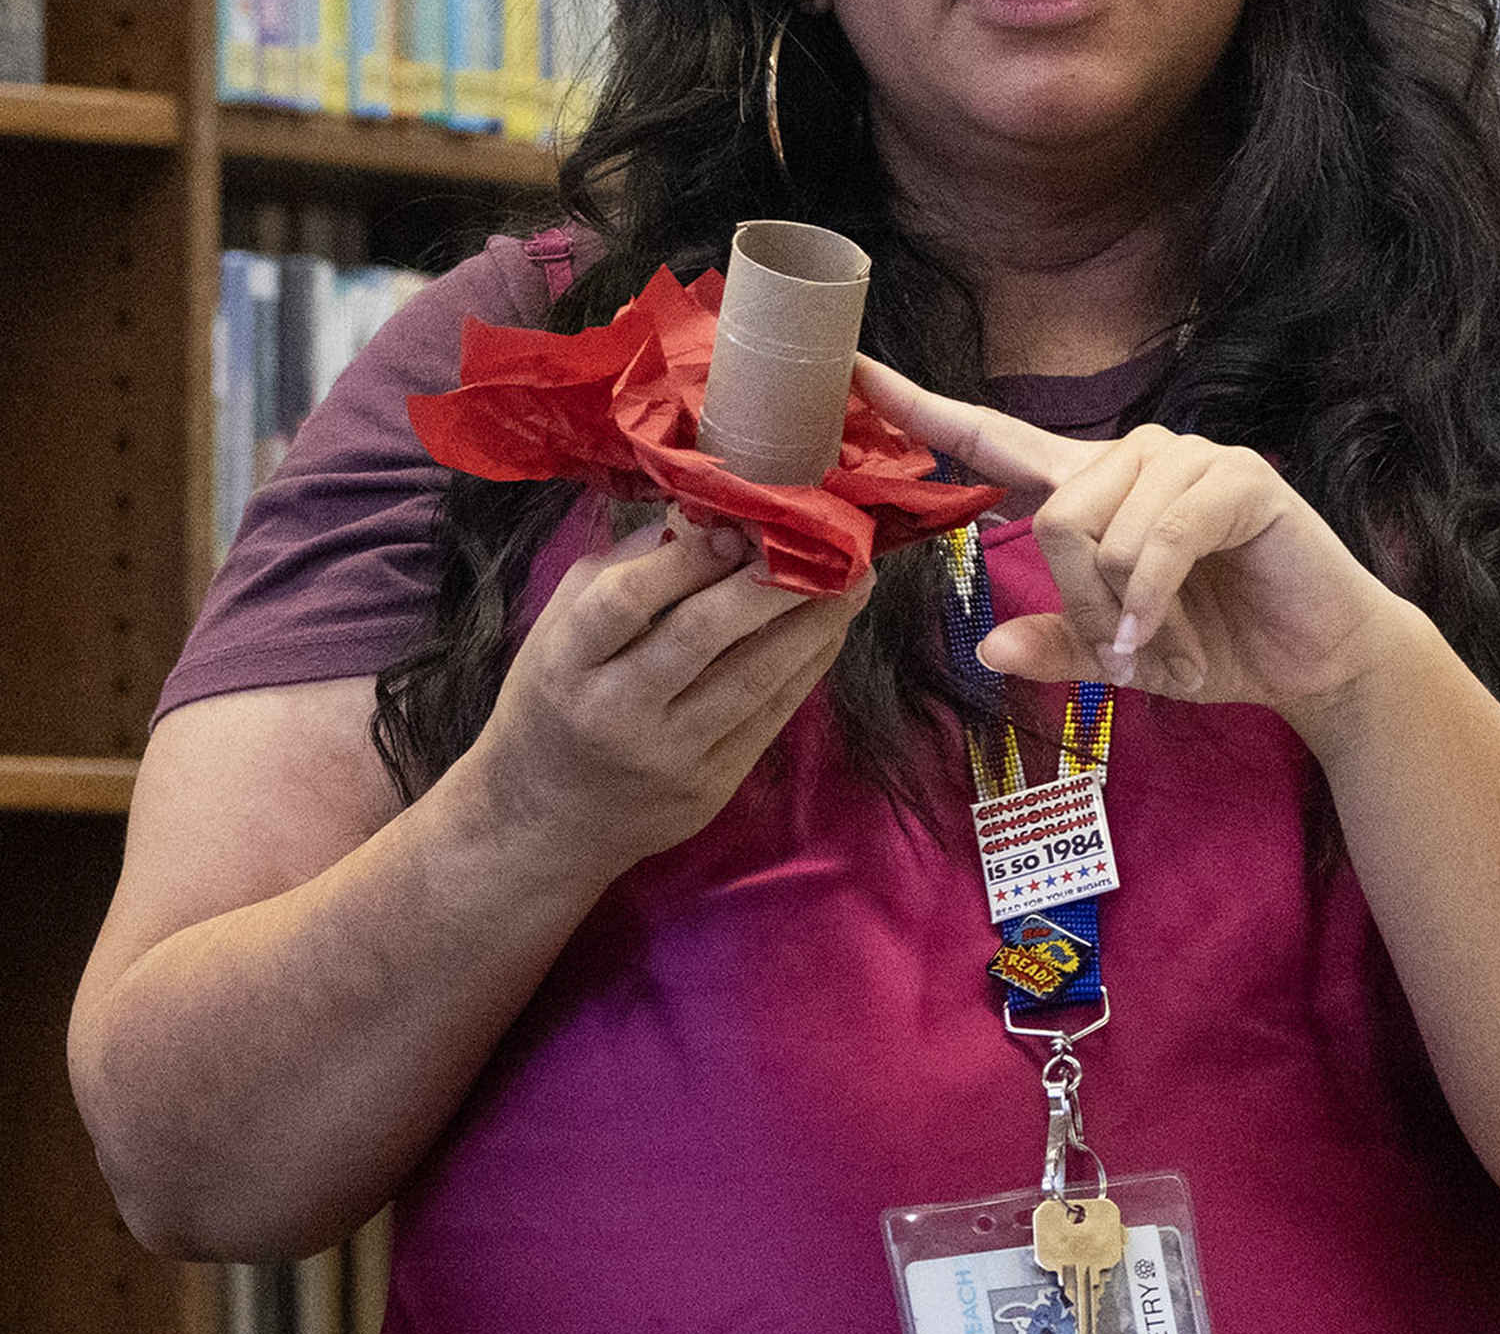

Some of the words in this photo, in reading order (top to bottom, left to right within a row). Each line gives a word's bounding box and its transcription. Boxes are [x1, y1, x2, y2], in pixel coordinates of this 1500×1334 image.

[976, 776, 1093, 820] CENSORSHIP
[979, 794, 1094, 837] CENSORSHIP
[982, 812, 1097, 855] CENSORSHIP
[985, 859, 1007, 881] is
[1011, 854, 1040, 874] so
[1042, 829, 1105, 864] 1984
[995, 902, 1022, 916] READ
[1023, 896, 1044, 908] FOR
[1045, 888, 1074, 901] YOUR
[1076, 878, 1113, 893] RIGHTS
[1007, 953, 1053, 985] READ!
